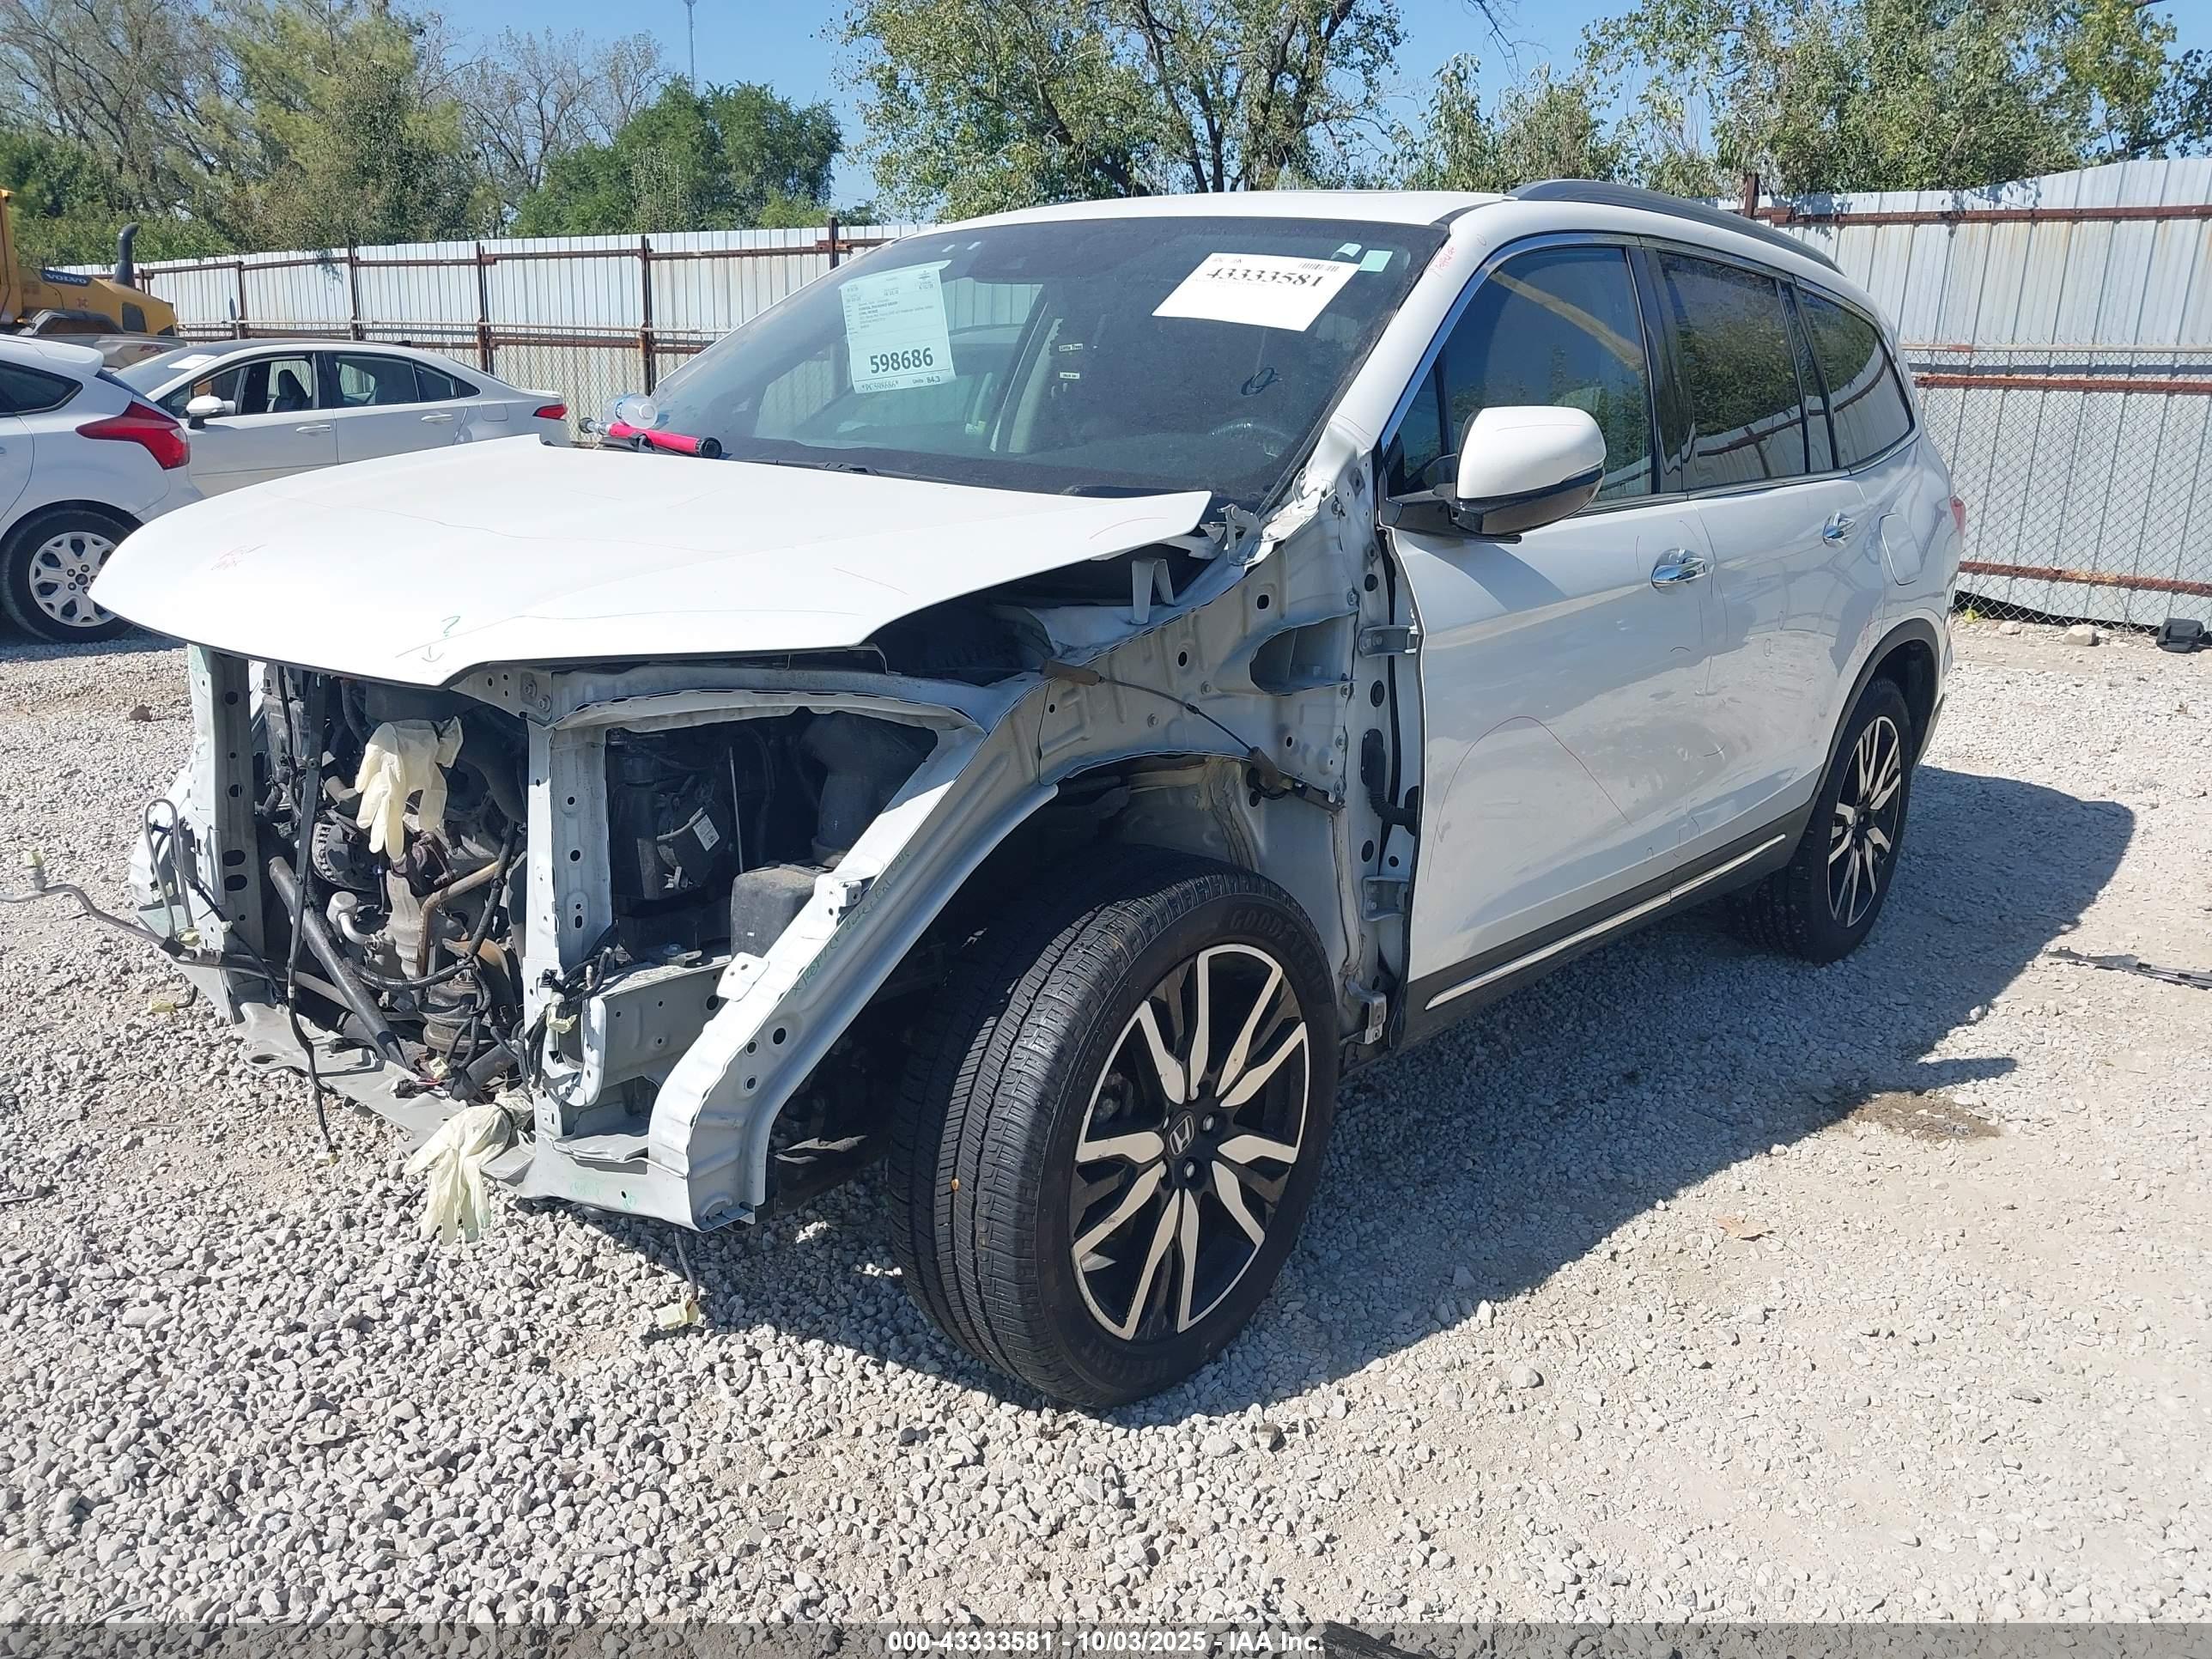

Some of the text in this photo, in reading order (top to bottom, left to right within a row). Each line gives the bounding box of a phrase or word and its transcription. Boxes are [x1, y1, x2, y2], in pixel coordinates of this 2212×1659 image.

[45, 273, 87, 284] VOLVO
[1206, 267, 1325, 288] 43333581
[870, 347, 934, 374] 598686
